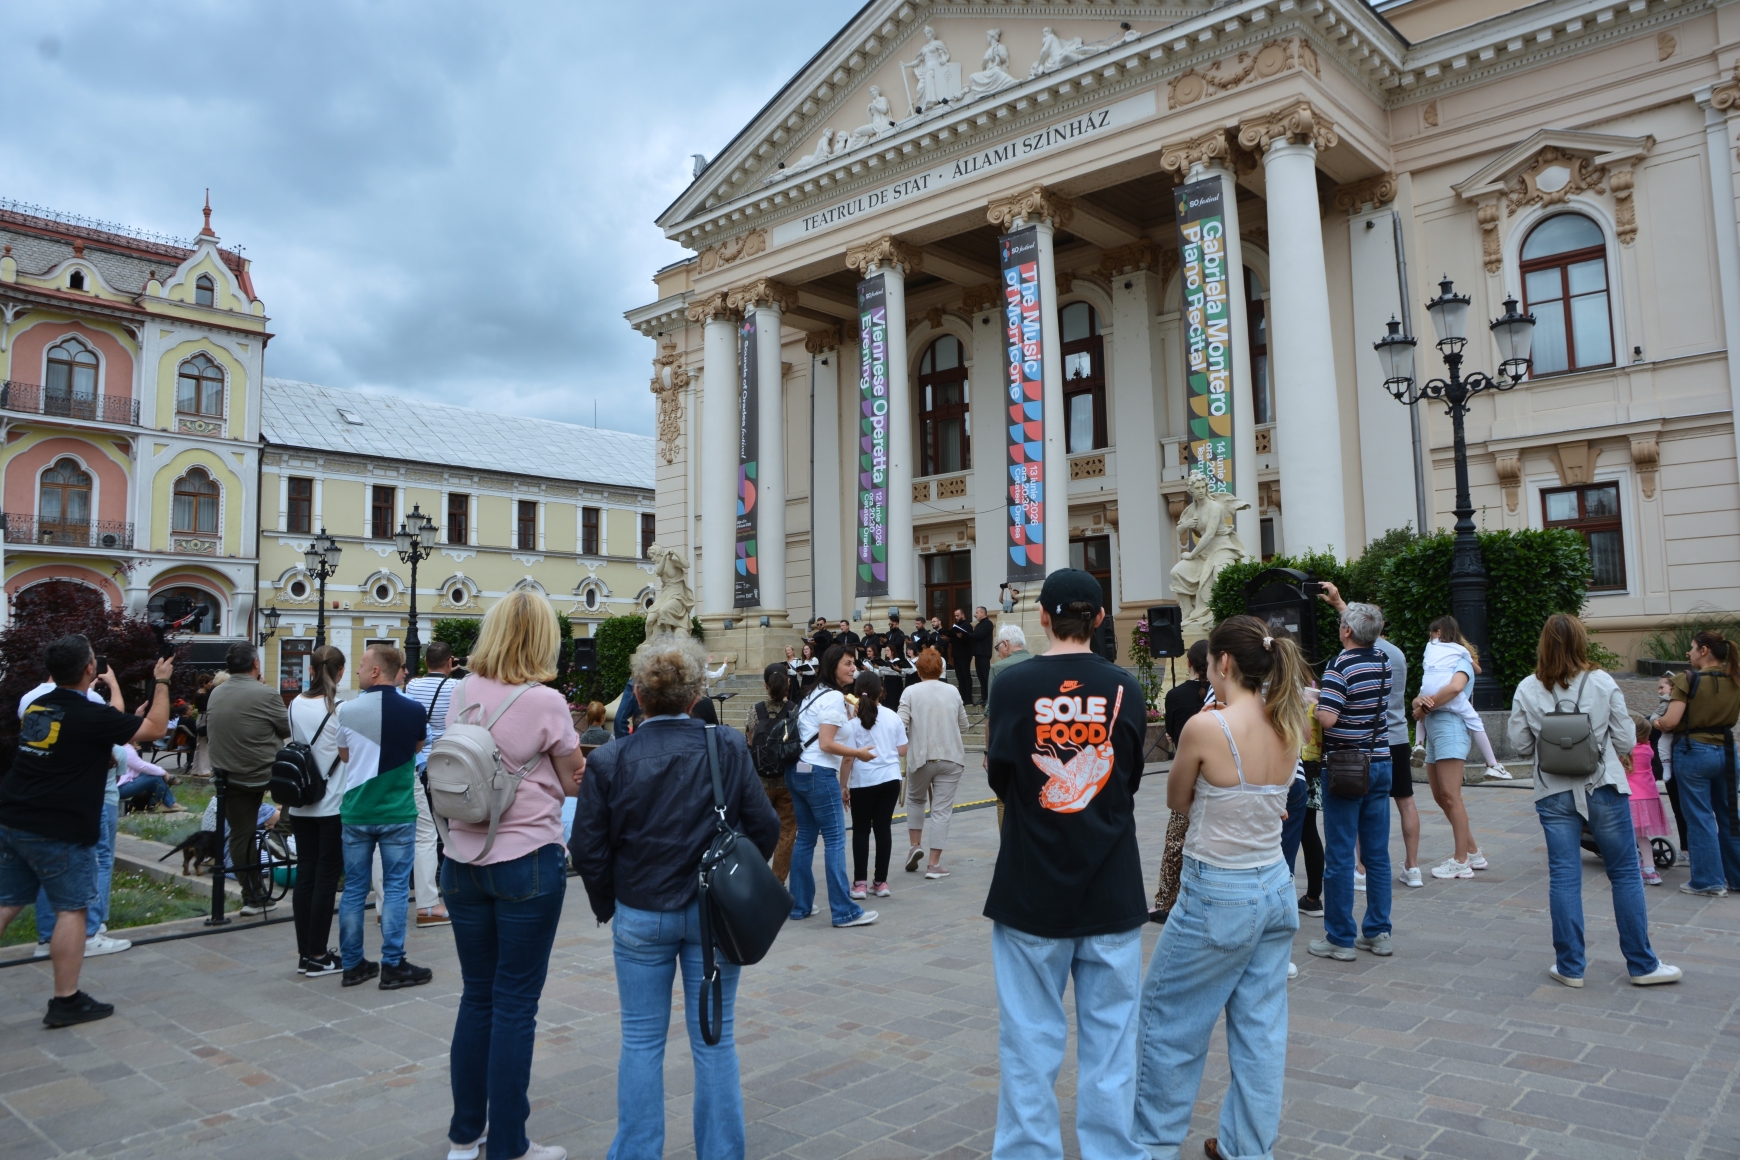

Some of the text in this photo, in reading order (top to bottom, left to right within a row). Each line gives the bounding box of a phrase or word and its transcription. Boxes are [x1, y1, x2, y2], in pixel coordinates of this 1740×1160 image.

[803, 110, 1110, 232] TEATRUL DE STAT ÁLLAMI SZÍNHÁZ
[1006, 271, 1022, 400] of Morricone
[1022, 264, 1041, 372] The Music
[1184, 225, 1207, 371] Piano Recital
[1203, 221, 1229, 416] Gabriela Montero
[743, 379, 747, 389] of
[860, 314, 871, 389] Evening
[870, 309, 888, 483] Viennese Operetta
[1030, 466, 1038, 476] 13
[1207, 461, 1216, 492] 20:30
[1217, 441, 1227, 493] 14 iunie 20
[1034, 696, 1108, 724] SOLE
[1036, 722, 1107, 746] FOOD
